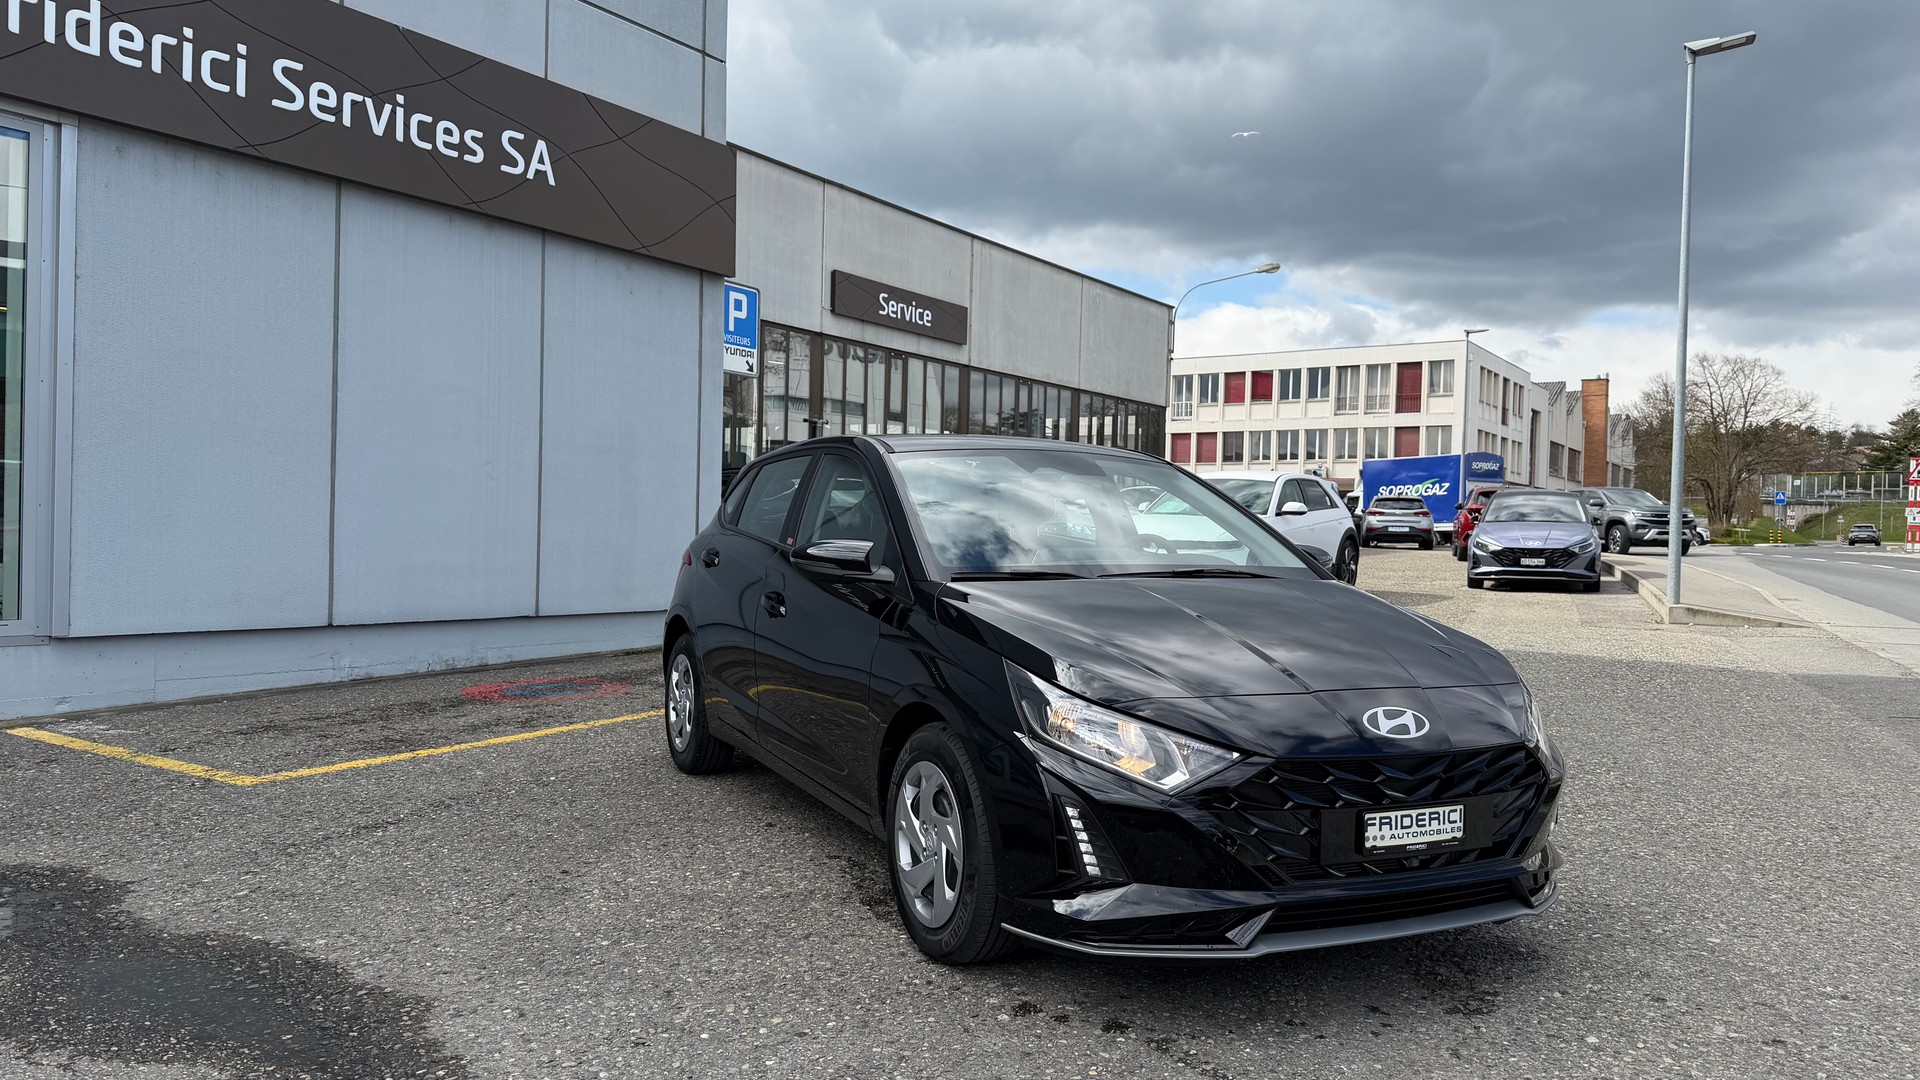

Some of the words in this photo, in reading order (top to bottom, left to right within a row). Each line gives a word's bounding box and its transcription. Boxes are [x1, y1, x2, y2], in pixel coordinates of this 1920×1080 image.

[7, 0, 248, 98] riderici
[271, 58, 485, 164] Services
[500, 129, 556, 186] SA
[728, 290, 748, 332] P
[878, 292, 932, 327] Service
[724, 333, 751, 346] VISITEURS
[724, 345, 755, 359] YUNDAI
[1470, 461, 1500, 471] SOPROGAZ
[1378, 482, 1450, 498] SOPROGAZ
[1365, 807, 1463, 833] FRIDERICI
[1389, 826, 1463, 840] AUTOMOBILES
